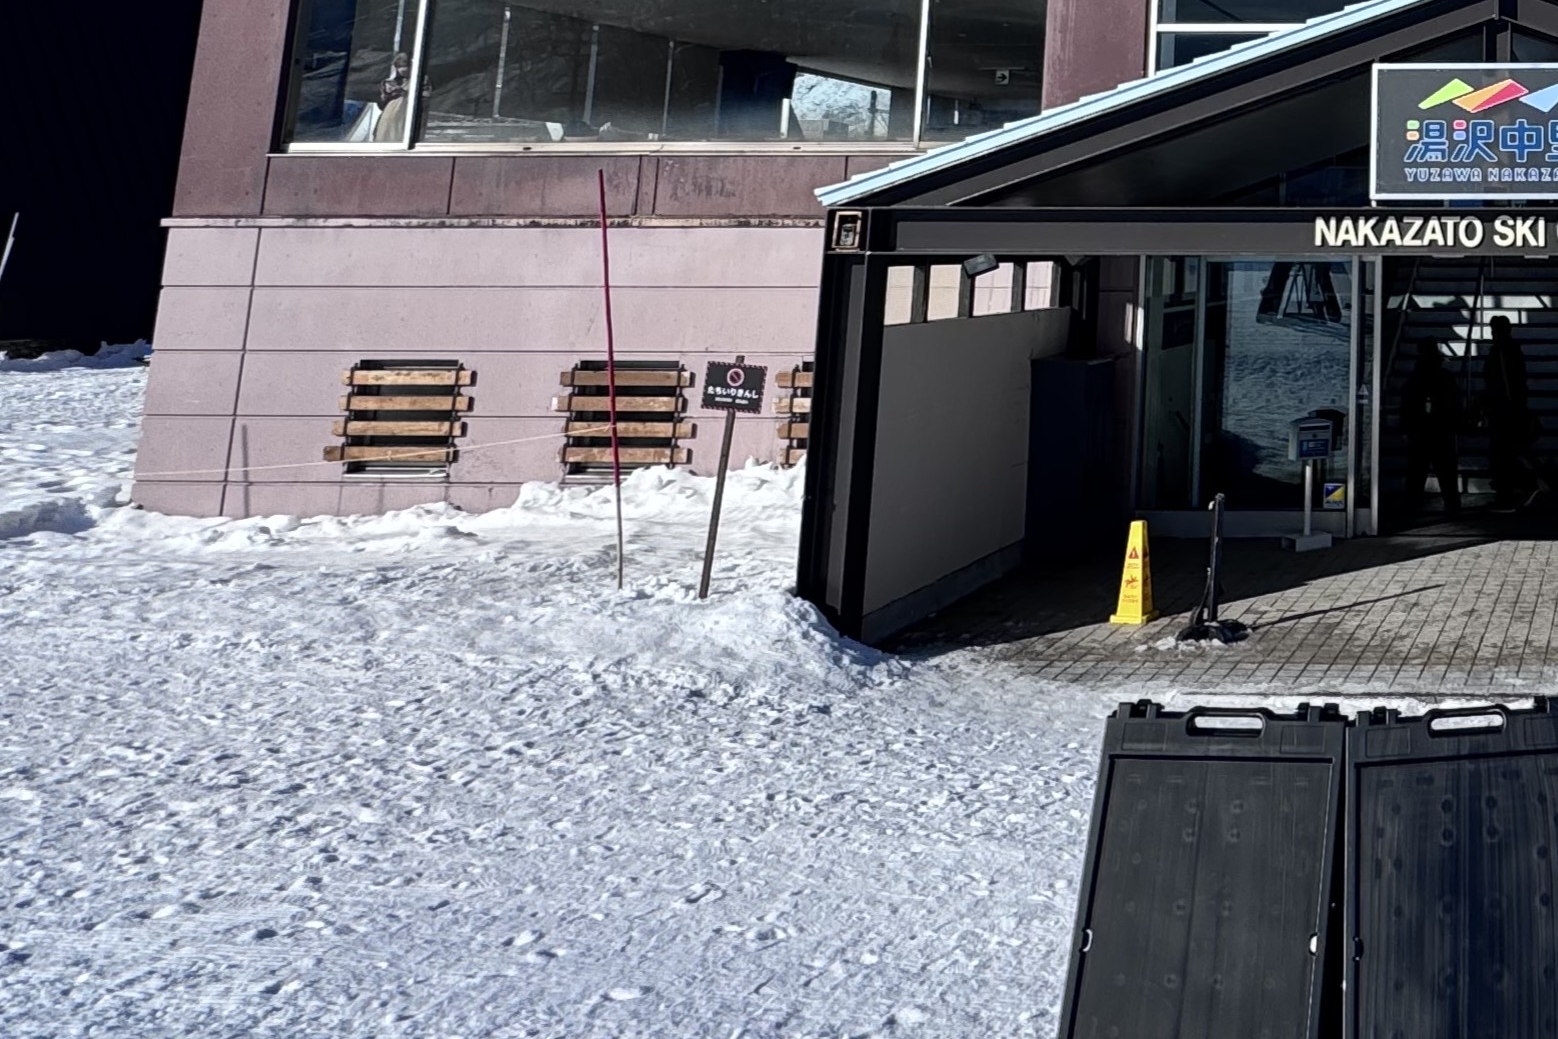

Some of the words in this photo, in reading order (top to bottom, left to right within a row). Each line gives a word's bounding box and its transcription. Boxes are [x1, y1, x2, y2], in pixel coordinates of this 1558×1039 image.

[1404, 167, 1482, 182] YUZAWA
[1314, 216, 1484, 248] NAKAZATO
[1493, 215, 1546, 248] SKI
